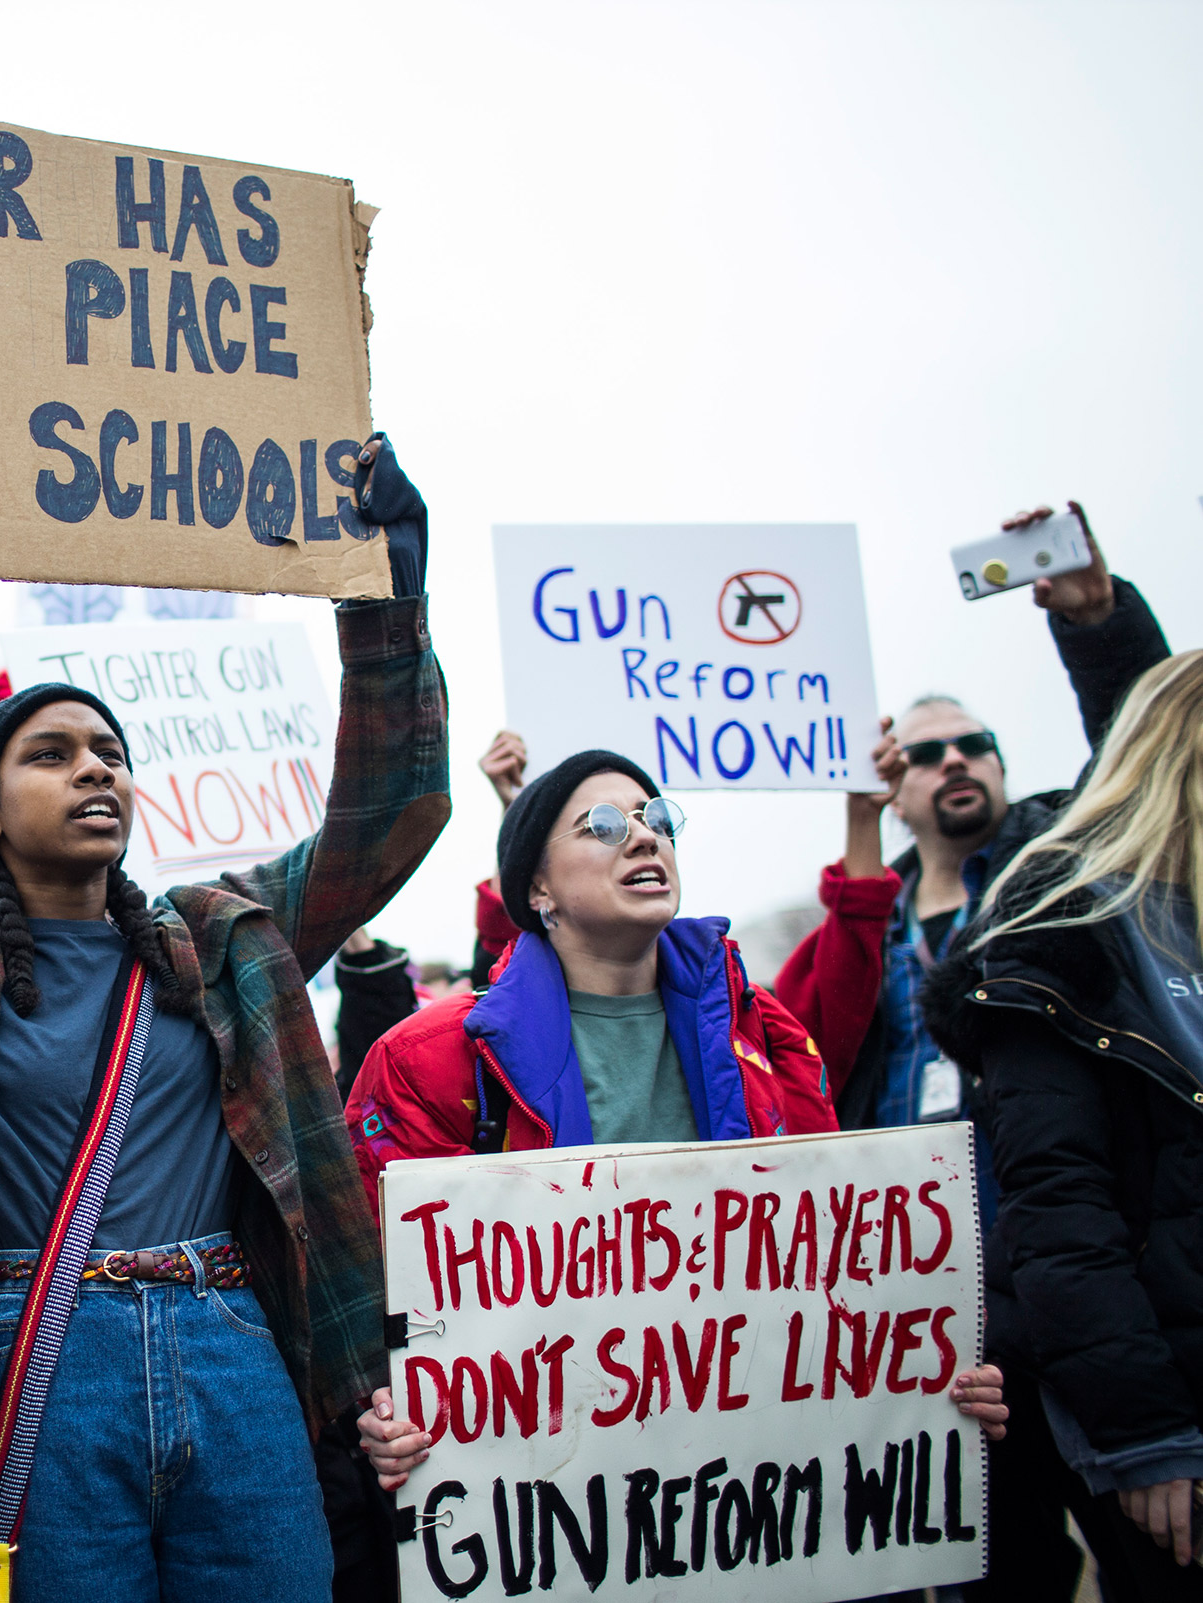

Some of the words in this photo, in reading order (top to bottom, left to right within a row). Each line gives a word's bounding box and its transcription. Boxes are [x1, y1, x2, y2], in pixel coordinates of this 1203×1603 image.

[115, 156, 280, 268] HAS
[29, 401, 380, 547] SCHOOLS
[533, 567, 671, 642] Gun
[39, 648, 210, 702] TIGHTER
[219, 639, 284, 694] GUN
[622, 648, 829, 703] Reform
[124, 713, 239, 765] ONTROL
[238, 703, 320, 752] LAWS
[655, 716, 848, 784] NOW!!
[401, 1199, 680, 1311] THOUGHTS
[714, 1181, 955, 1291] PRAYERS
[406, 1334, 574, 1449] DON'T
[592, 1314, 748, 1428] SAVE
[781, 1306, 957, 1402] LIVES
[423, 1474, 609, 1599] GUN
[625, 1457, 822, 1586] REFORM
[844, 1428, 977, 1555] WILL
